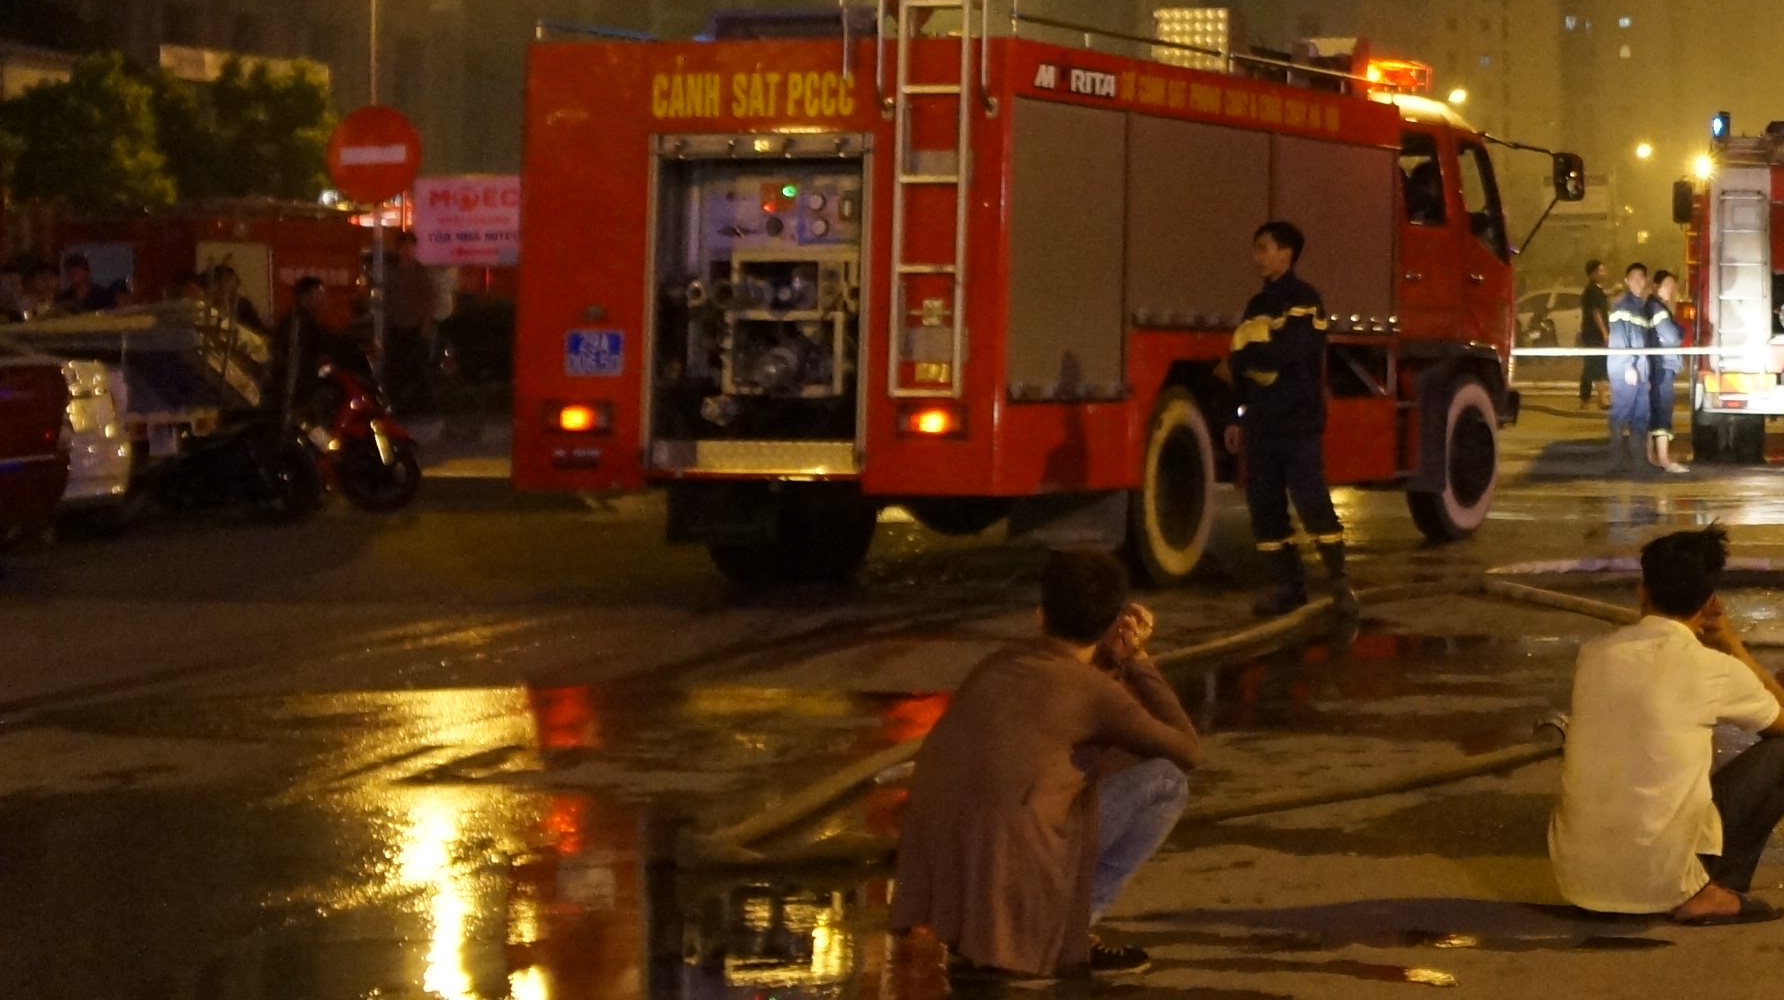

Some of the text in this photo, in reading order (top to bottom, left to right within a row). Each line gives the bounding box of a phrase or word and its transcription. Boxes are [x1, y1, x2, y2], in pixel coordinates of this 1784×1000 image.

[652, 55, 855, 118] CẢNH SÁT PCCC
[1034, 64, 1116, 98] MRITA
